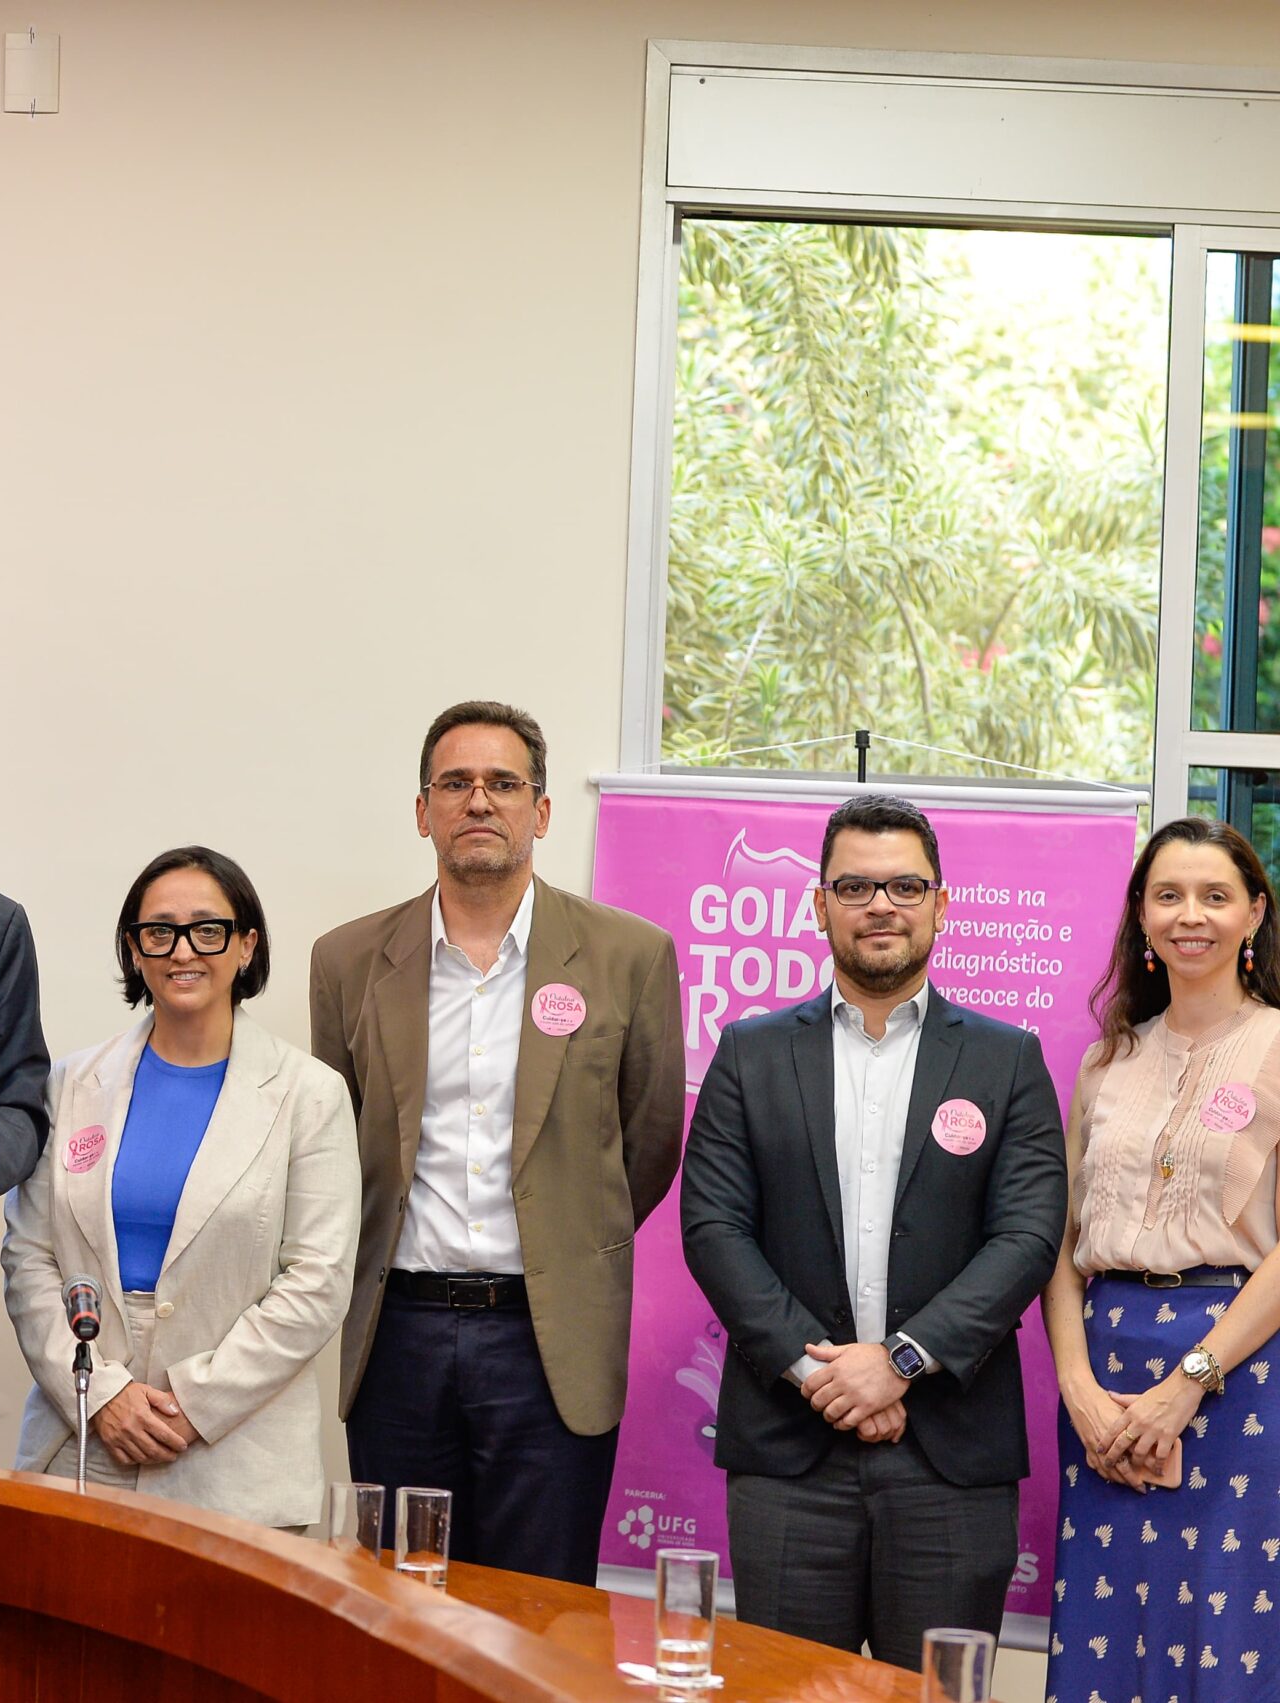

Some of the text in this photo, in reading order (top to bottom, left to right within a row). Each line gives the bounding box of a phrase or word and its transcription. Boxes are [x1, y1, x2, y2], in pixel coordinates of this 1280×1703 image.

[1017, 889, 1046, 907] na
[935, 918, 1073, 946] prevenção e
[931, 946, 1063, 977] diagnóstico
[548, 1000, 583, 1012] ROSA
[1025, 985, 1054, 1009] do
[1220, 1096, 1250, 1119] ROSA
[950, 1117, 983, 1130] ROSA
[79, 1134, 105, 1152] ROSA
[624, 1488, 667, 1501] PARCERIA:
[658, 1514, 697, 1535] UFG
